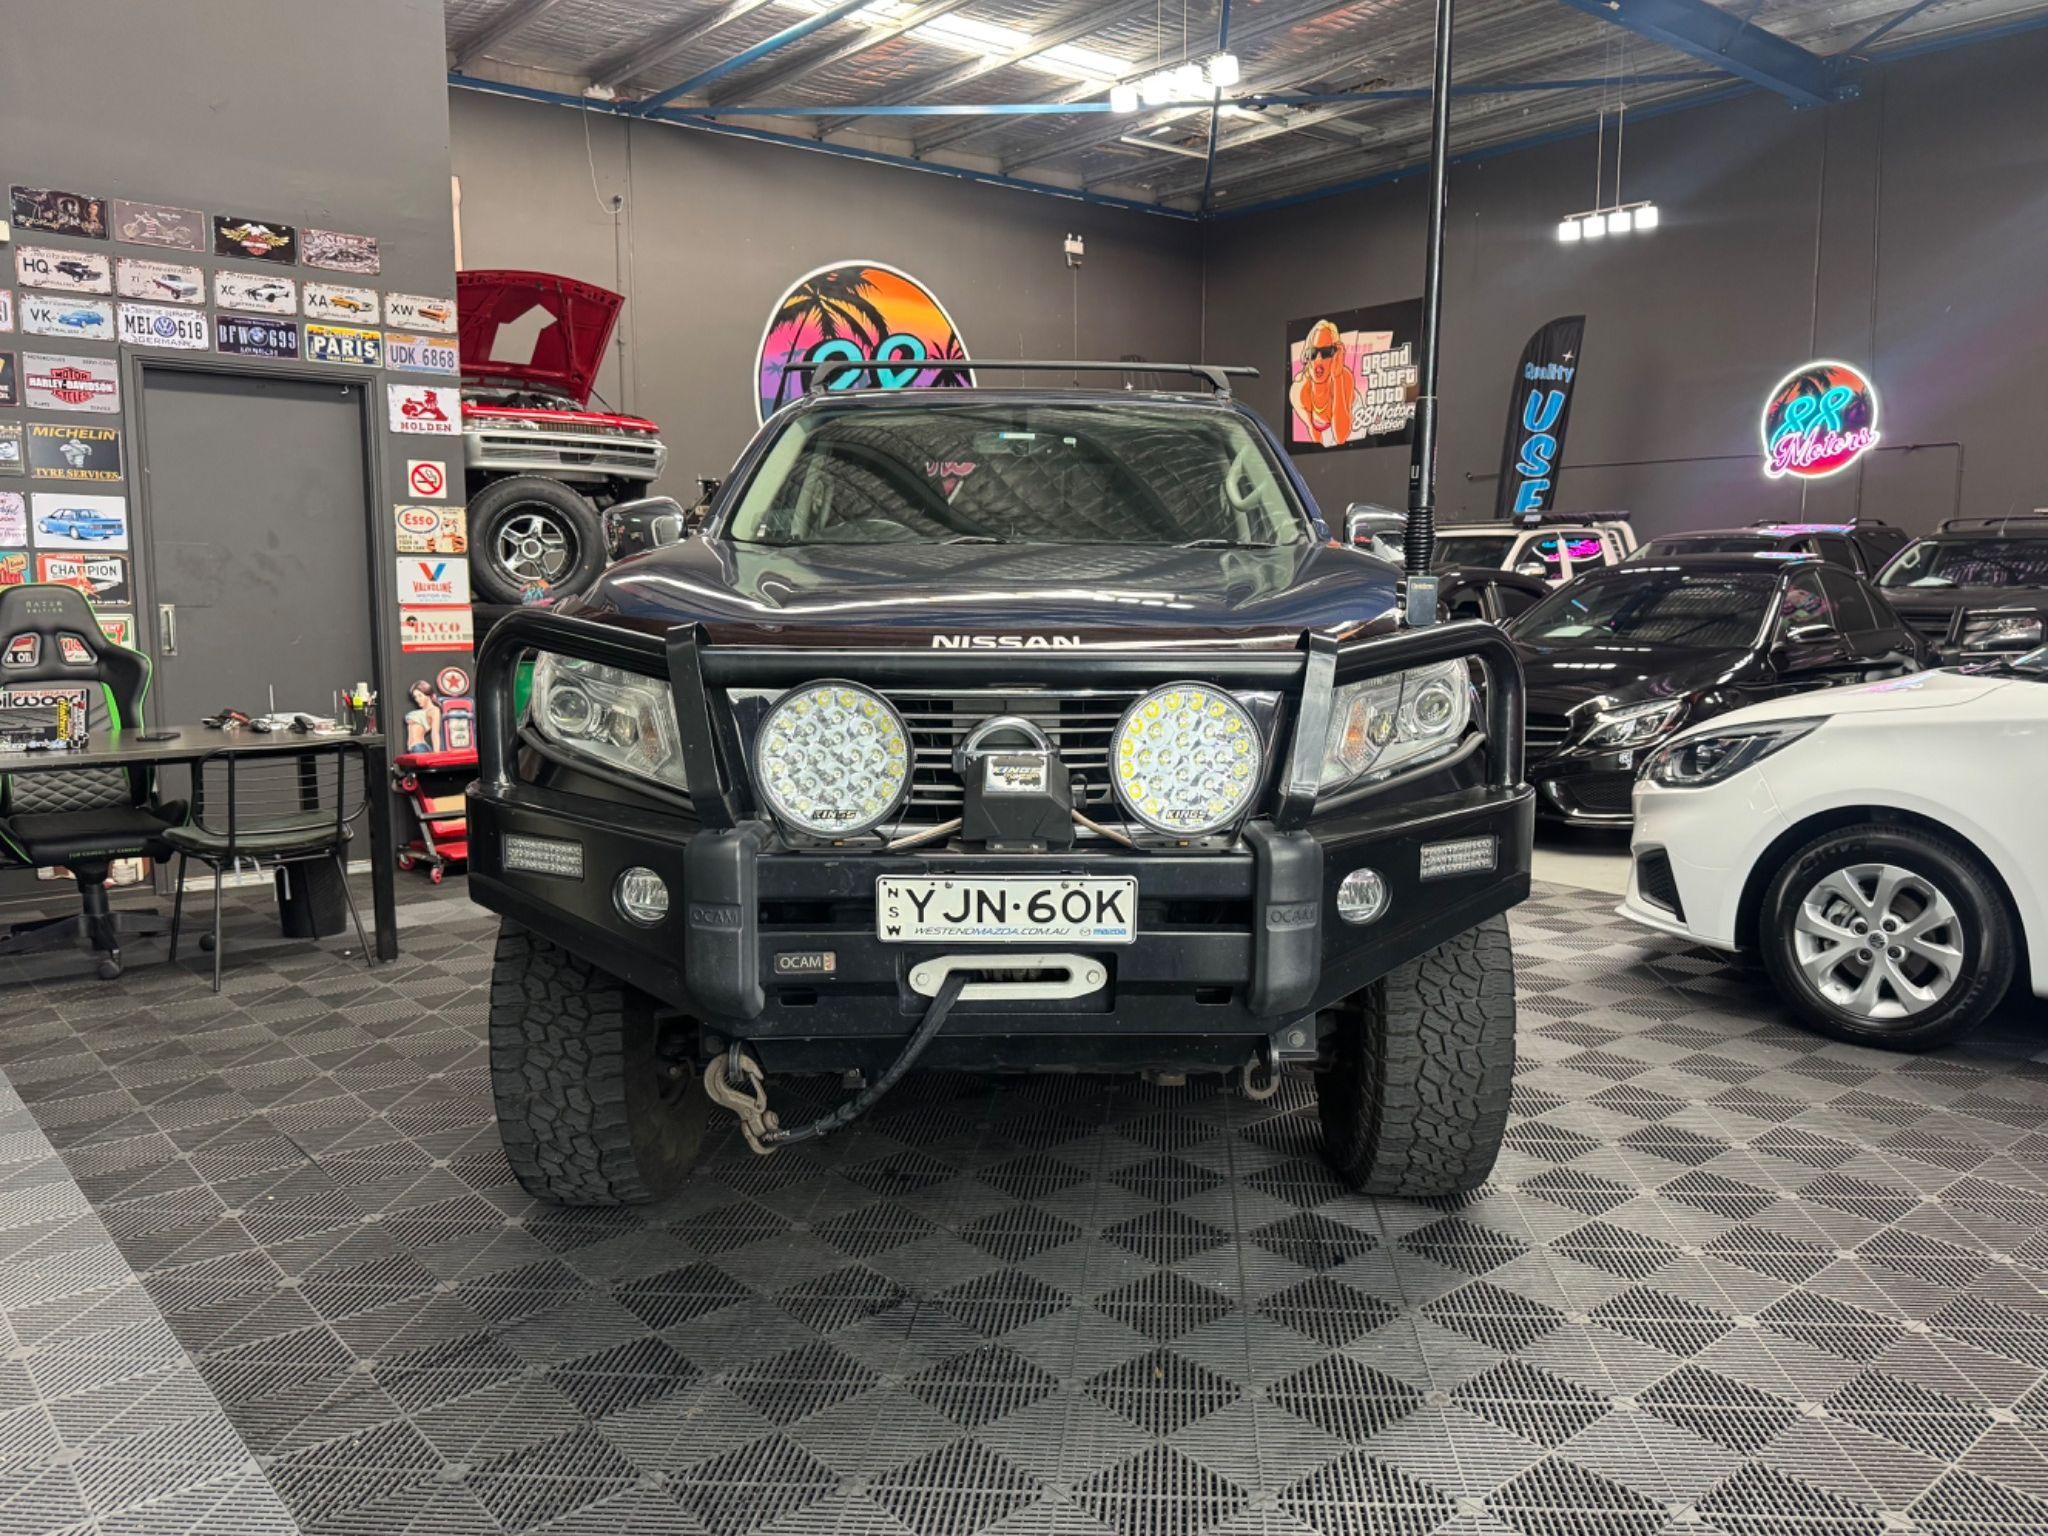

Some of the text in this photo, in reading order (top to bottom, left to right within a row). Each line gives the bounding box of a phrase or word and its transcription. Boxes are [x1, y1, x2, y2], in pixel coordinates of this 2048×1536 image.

[23, 257, 49, 275] HQ
[221, 284, 236, 296] XC
[309, 293, 327, 308] XA
[30, 307, 52, 323] VK
[391, 303, 414, 316] XW
[125, 314, 203, 340] MEL 618
[313, 335, 376, 358] PARIS
[390, 346, 455, 368] UDK 6868
[1525, 362, 1575, 383] Quality
[29, 377, 114, 394] HARLEY-DAVIDSON
[32, 426, 116, 441] MICHELIN
[400, 422, 452, 432] HOLDEN
[1769, 424, 1873, 474] Motors
[35, 467, 119, 480] TYRE SERVICES
[412, 581, 453, 593] VALVOLINE
[414, 621, 461, 634] RYCO
[414, 634, 462, 642] FILTERS
[931, 635, 1081, 649] NISSAN
[692, 907, 738, 925] OCAM
[1270, 905, 1313, 923] OCAM
[913, 926, 1071, 937] WESTENDMAZDA.COM.AU
[780, 956, 822, 969] OCAM
